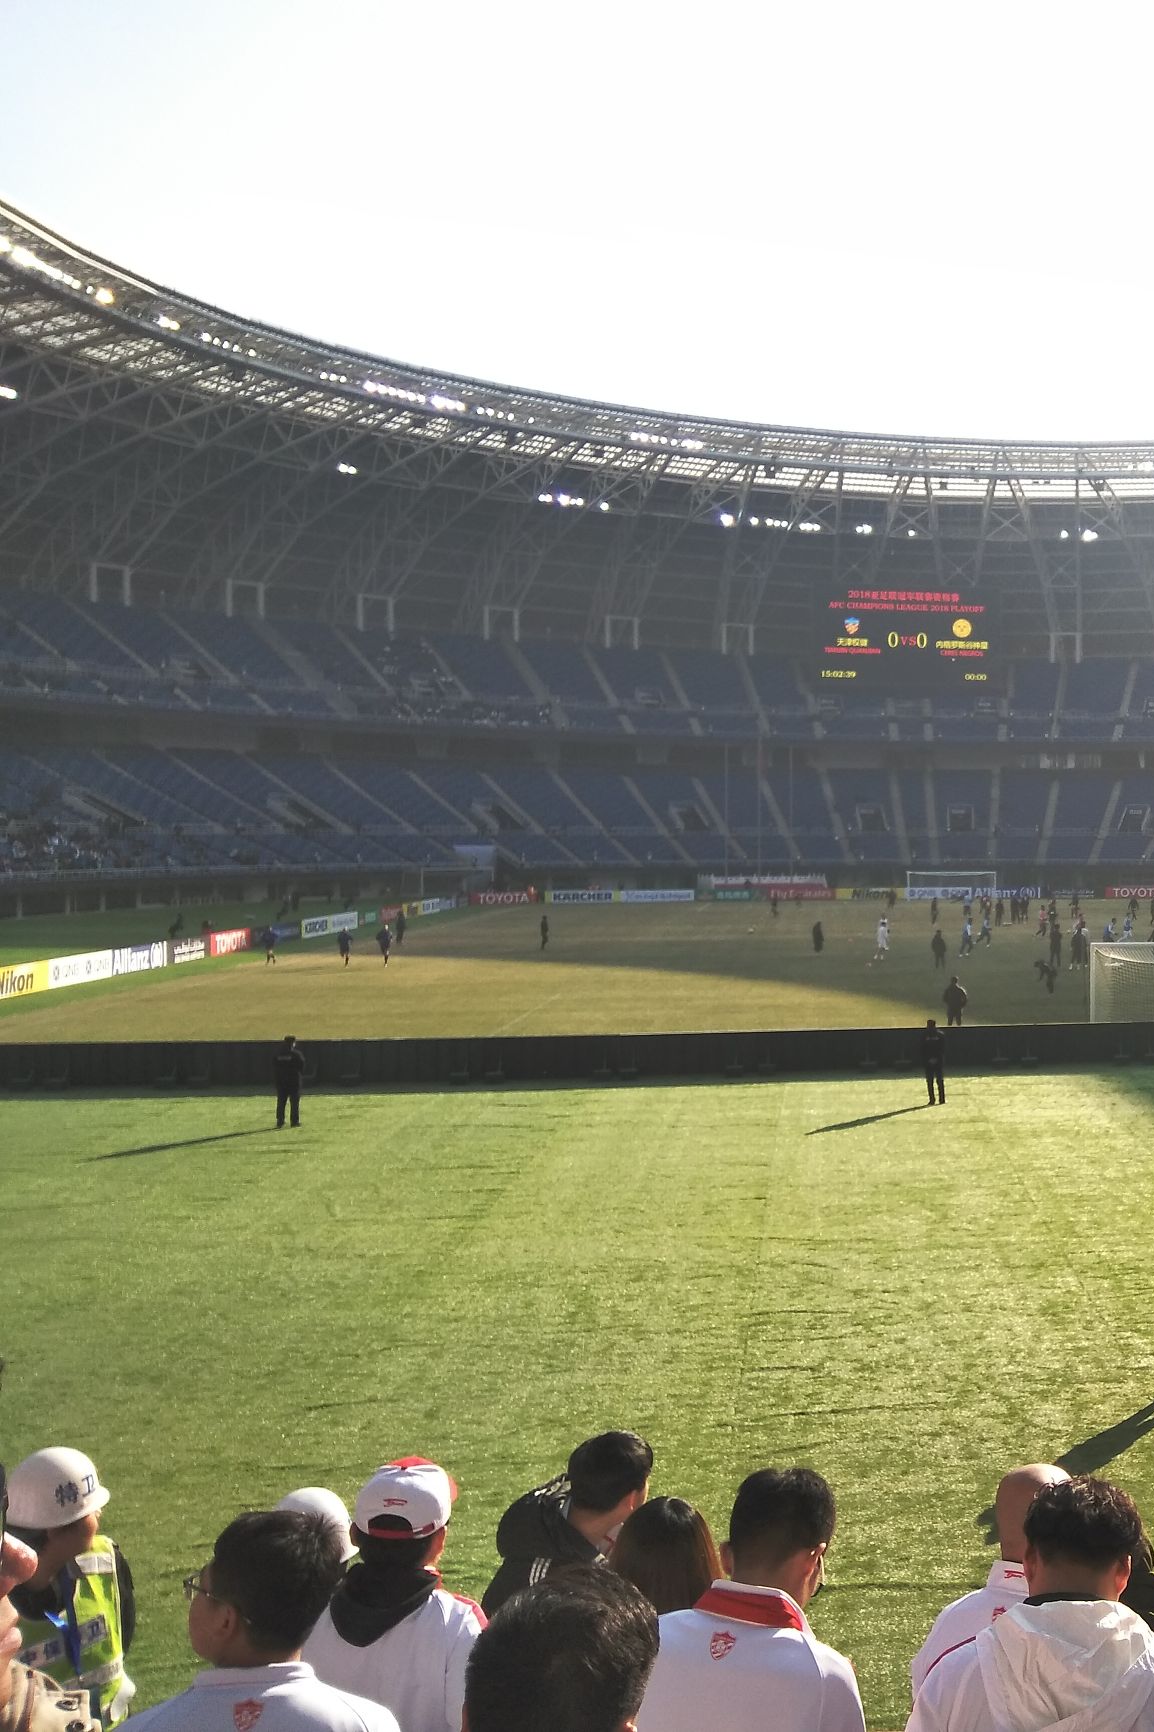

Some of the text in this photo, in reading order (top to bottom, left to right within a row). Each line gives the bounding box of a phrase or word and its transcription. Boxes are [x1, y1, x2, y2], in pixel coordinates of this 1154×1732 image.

[828, 601, 985, 613] AFC CHAMPIONS LEAGUE 2018 PLAYOFF
[887, 631, 899, 648] 0
[916, 632, 928, 649] 0
[964, 673, 987, 681] 00:00
[479, 892, 529, 905] TOYOTA
[214, 929, 248, 955] TOYOTA
[112, 946, 151, 975] Allianz
[0, 969, 34, 995] Nikon
